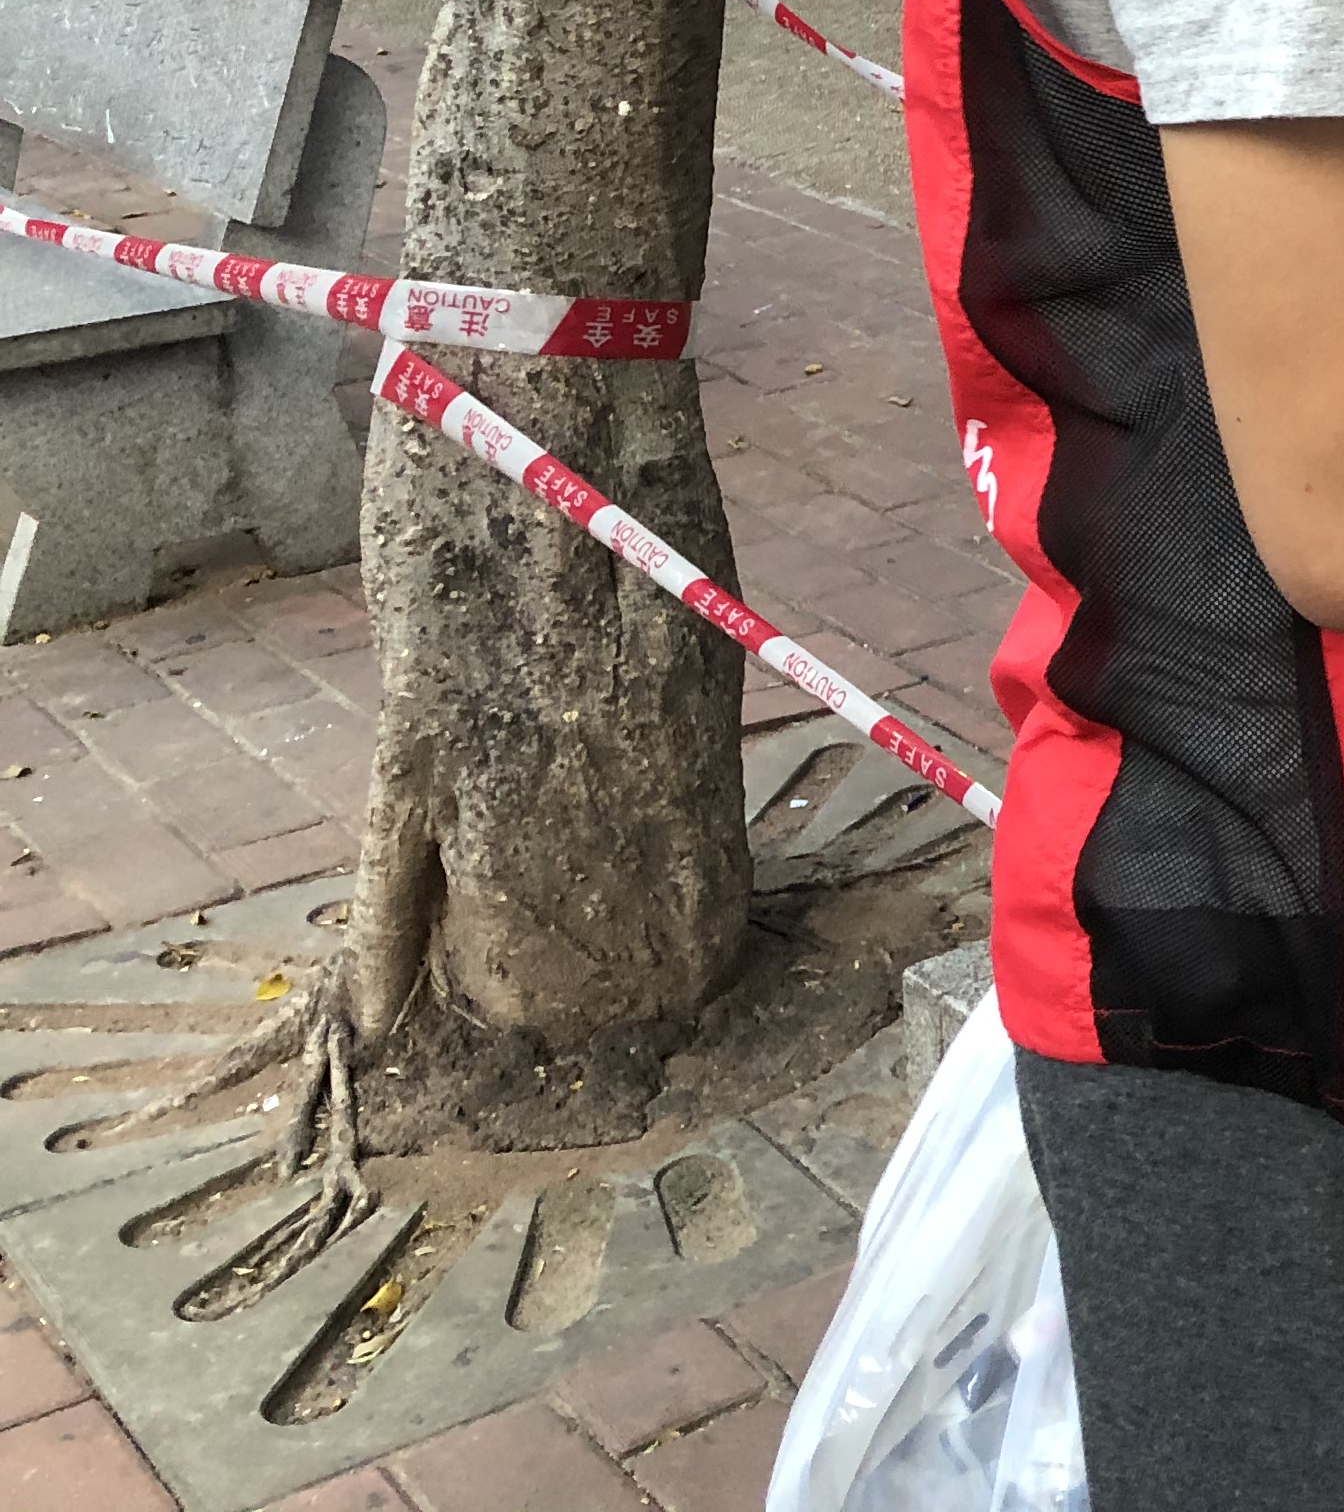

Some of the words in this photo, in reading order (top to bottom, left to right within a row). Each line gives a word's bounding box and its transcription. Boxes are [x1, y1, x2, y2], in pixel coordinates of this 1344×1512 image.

[228, 259, 261, 278] SAFE
[343, 277, 381, 299] SAFE
[403, 304, 490, 338] 注意
[407, 287, 512, 315] CAUTION
[596, 305, 680, 326] SAFE
[582, 320, 664, 349] 安全
[406, 360, 445, 400] SAFE
[463, 407, 514, 453] CAUTION
[539, 464, 589, 509] SAFE
[611, 519, 671, 570] CAUTION
[699, 587, 756, 636] SAFE
[782, 651, 848, 710] CAUTION
[888, 730, 948, 790] SAFE
